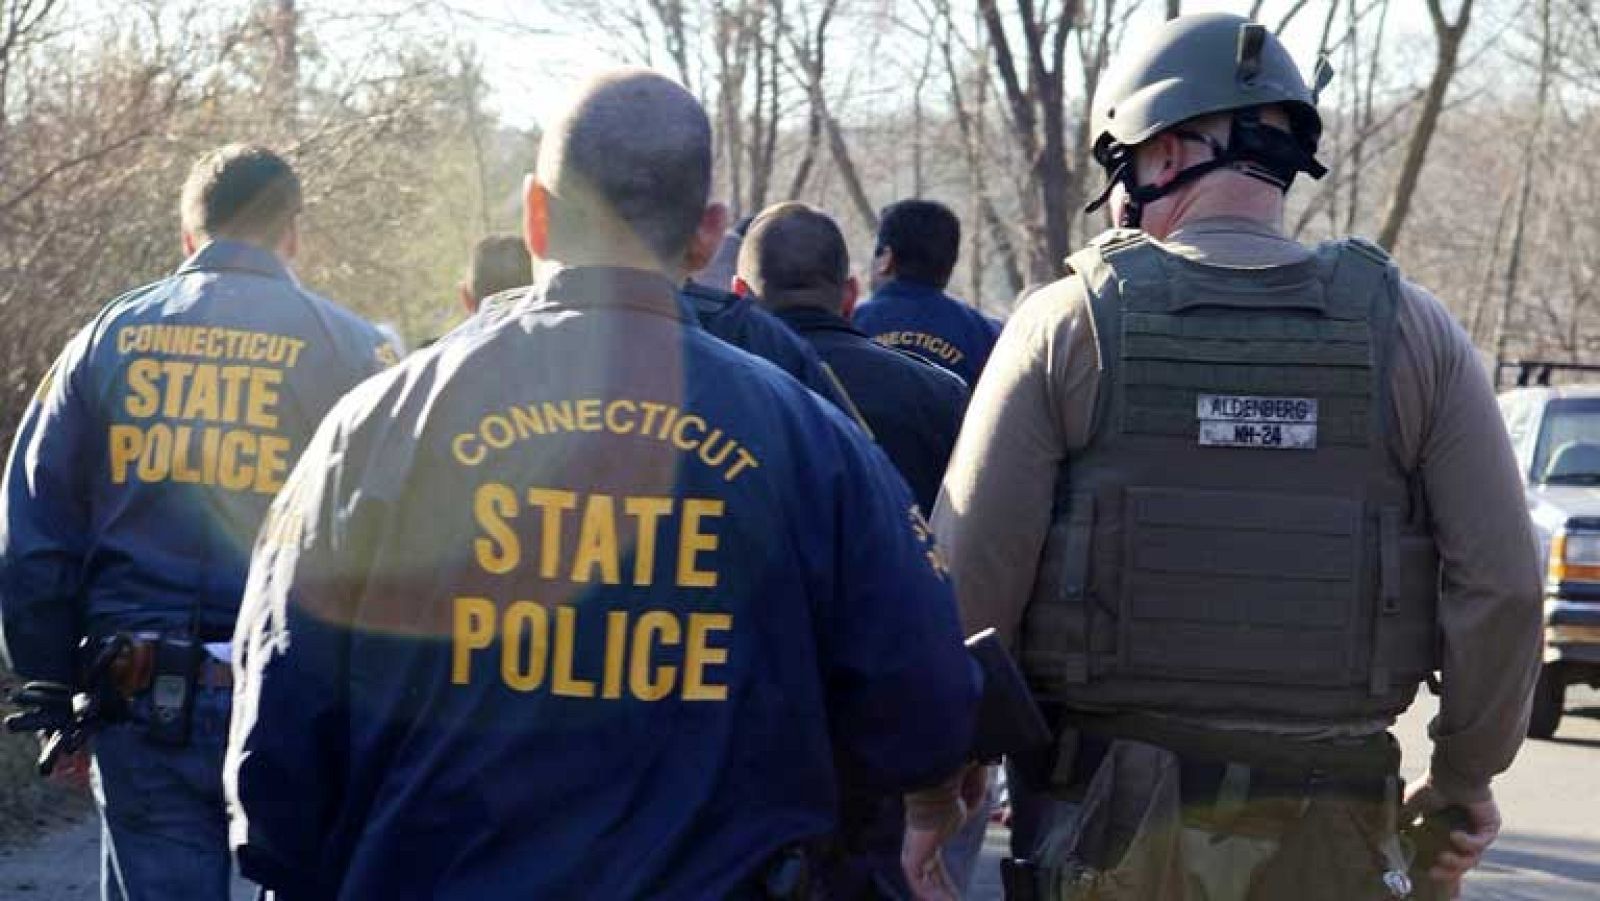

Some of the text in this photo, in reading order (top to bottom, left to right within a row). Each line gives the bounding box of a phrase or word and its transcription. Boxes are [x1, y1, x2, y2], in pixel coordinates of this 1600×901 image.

[118, 325, 304, 367] CONNECTICUT
[125, 359, 283, 428] STATE
[109, 423, 292, 493] POLICE
[452, 399, 759, 482] CONNECTICUT
[474, 483, 726, 587] STATE
[451, 598, 734, 701] POLICE
